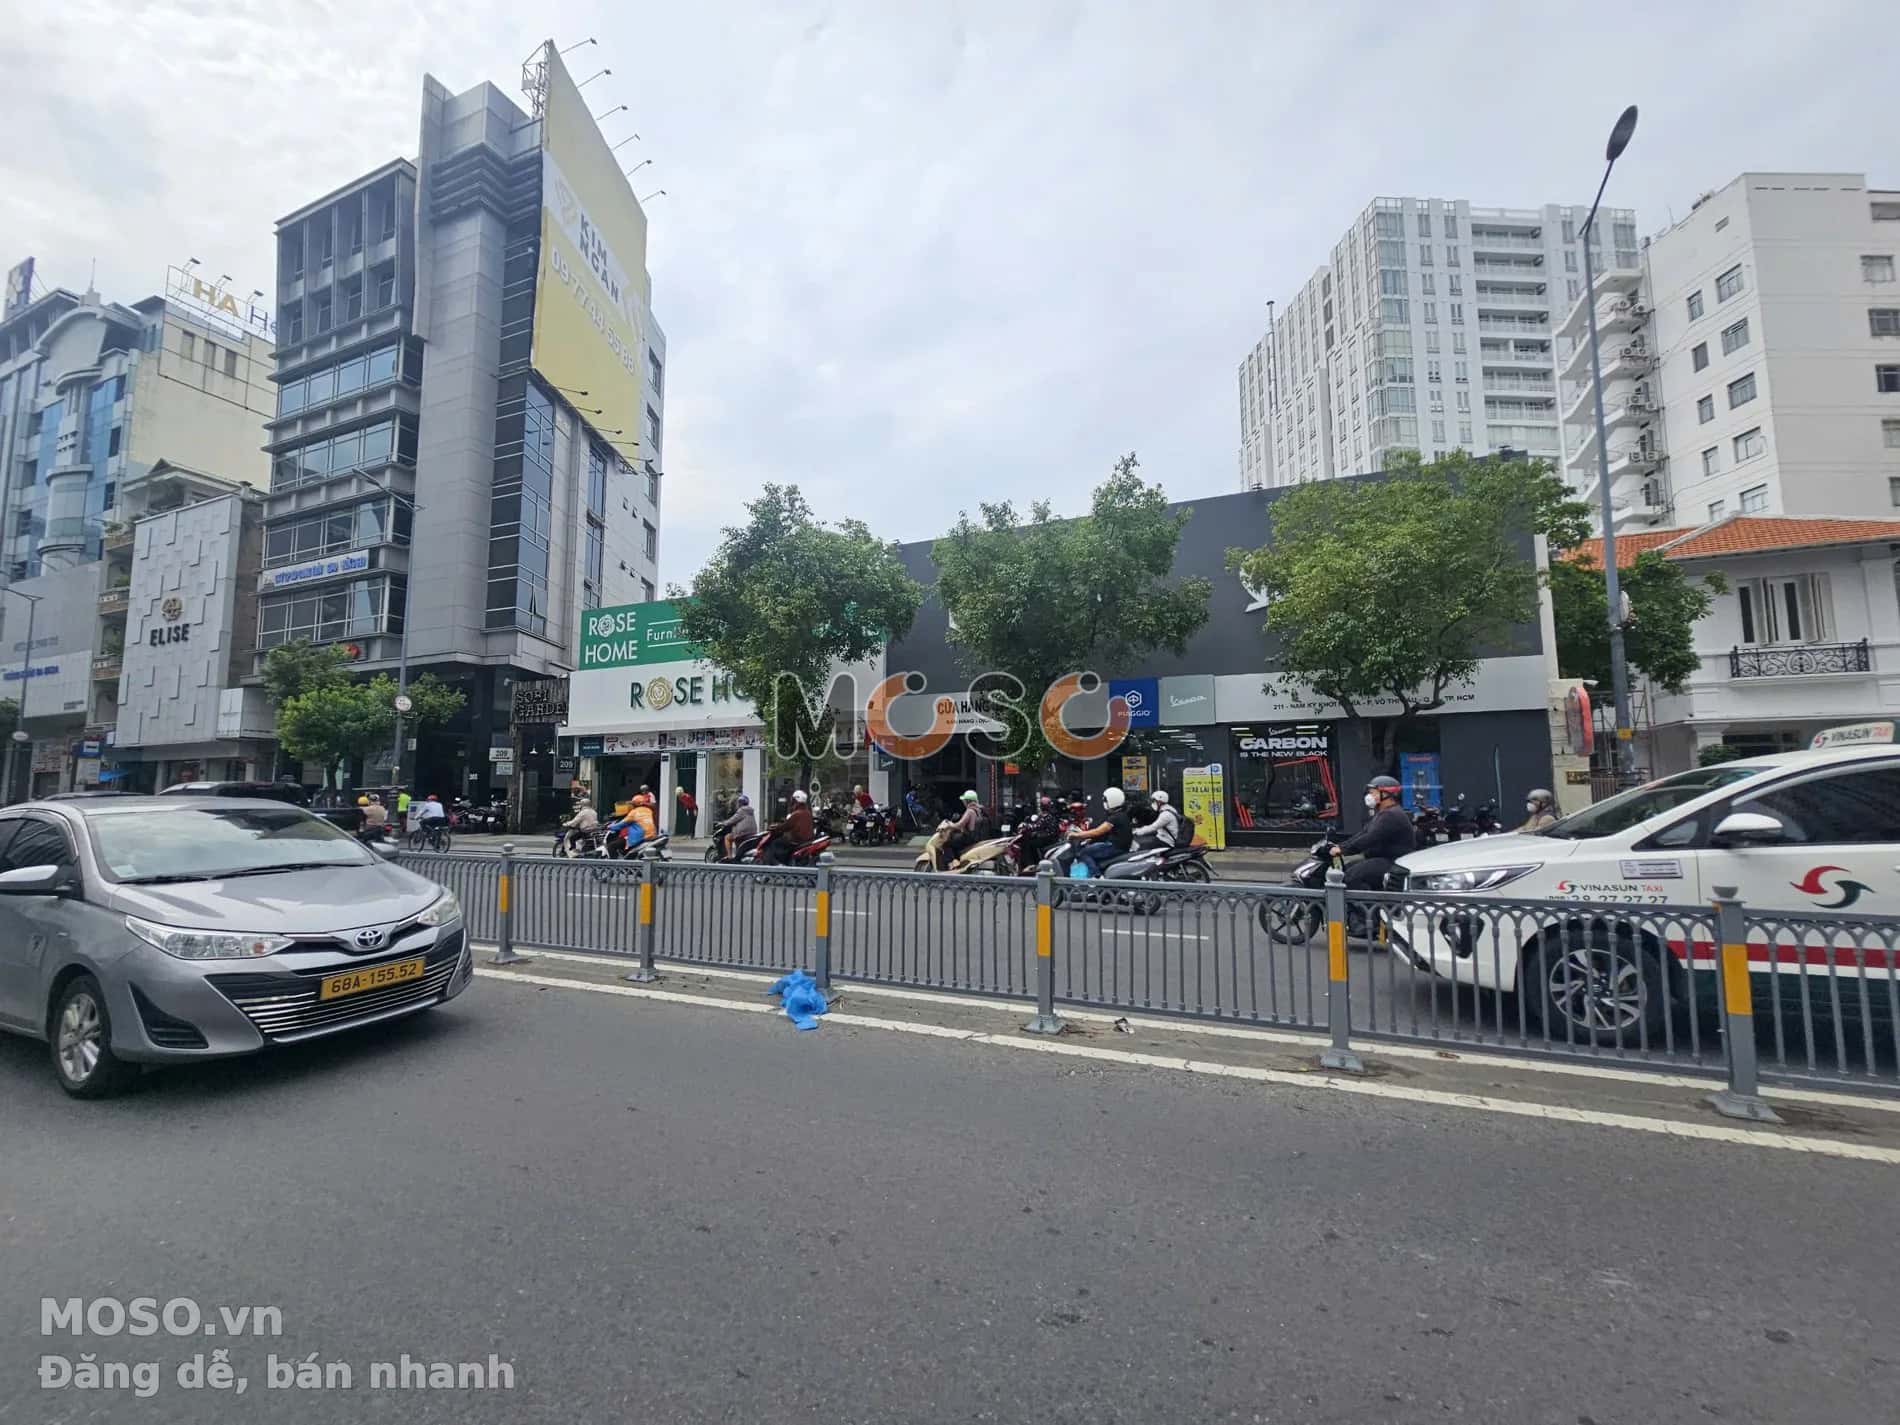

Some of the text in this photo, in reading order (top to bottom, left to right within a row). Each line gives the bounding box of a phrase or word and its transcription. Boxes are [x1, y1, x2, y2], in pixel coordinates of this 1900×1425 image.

[580, 212, 608, 268] KIM
[149, 623, 190, 647] ELISE
[588, 611, 637, 637] ROSE
[584, 639, 639, 665] HOME
[630, 676, 704, 710] ROSE
[1240, 736, 1328, 750] CARBON
[559, 760, 574, 769] 209
[1580, 884, 1664, 892] VINASUN TAXI
[331, 963, 417, 993] 68A-155.52
